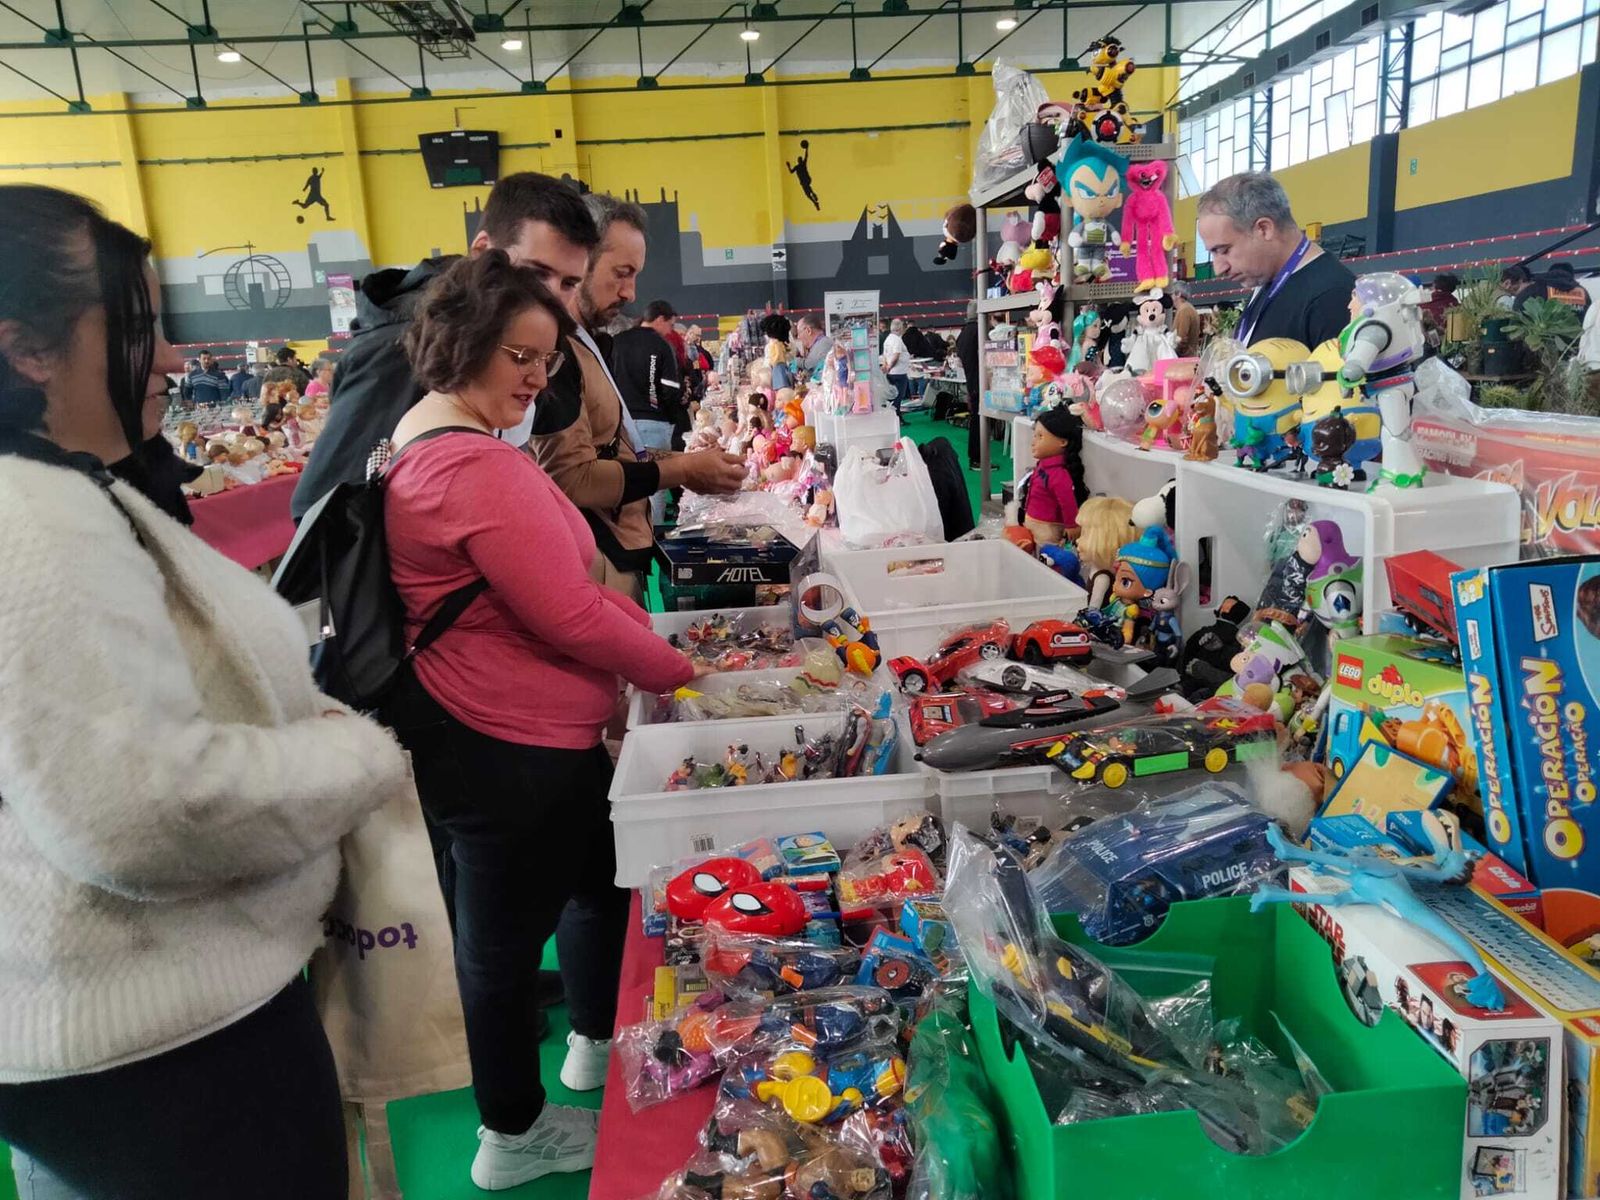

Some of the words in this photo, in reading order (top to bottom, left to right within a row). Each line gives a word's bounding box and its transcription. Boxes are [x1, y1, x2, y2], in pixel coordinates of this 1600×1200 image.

[1535, 470, 1600, 544] VOL
[716, 567, 772, 582] HOTEL
[1339, 663, 1361, 679] LEGO
[1367, 674, 1425, 709] duplo
[1519, 656, 1586, 861] OPERACIÓN
[1089, 839, 1119, 865] POLICE
[1202, 862, 1249, 888] POLICE
[1512, 902, 1537, 912] mobil
